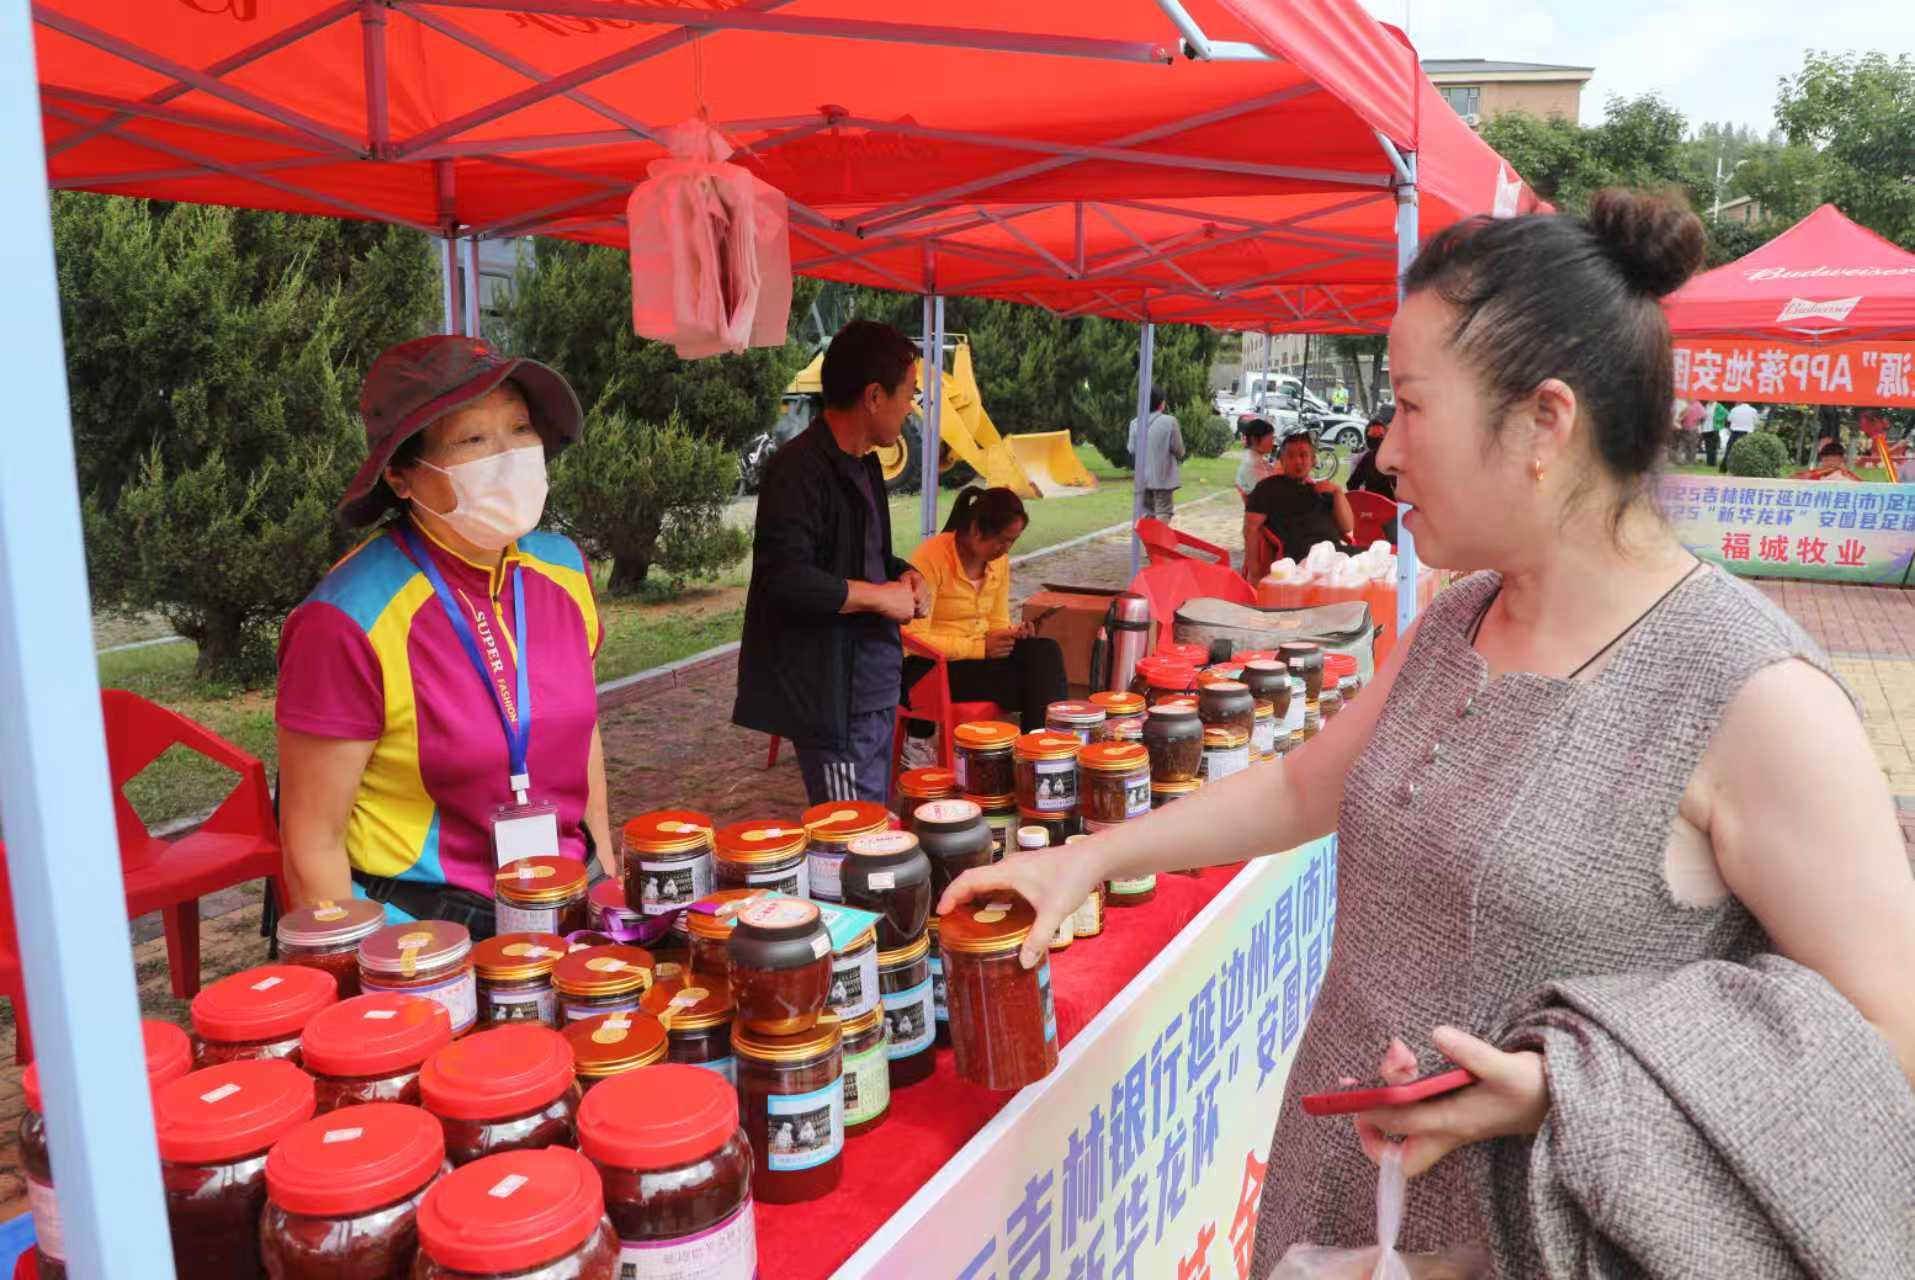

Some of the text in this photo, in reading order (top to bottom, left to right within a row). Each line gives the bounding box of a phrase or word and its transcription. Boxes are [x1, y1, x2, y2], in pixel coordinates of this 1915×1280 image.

[1721, 531, 1867, 566] 福城牧业
[476, 611, 518, 723] SUPER FASHION
[955, 834, 1337, 1280] 吉林银行延边州县(市)
